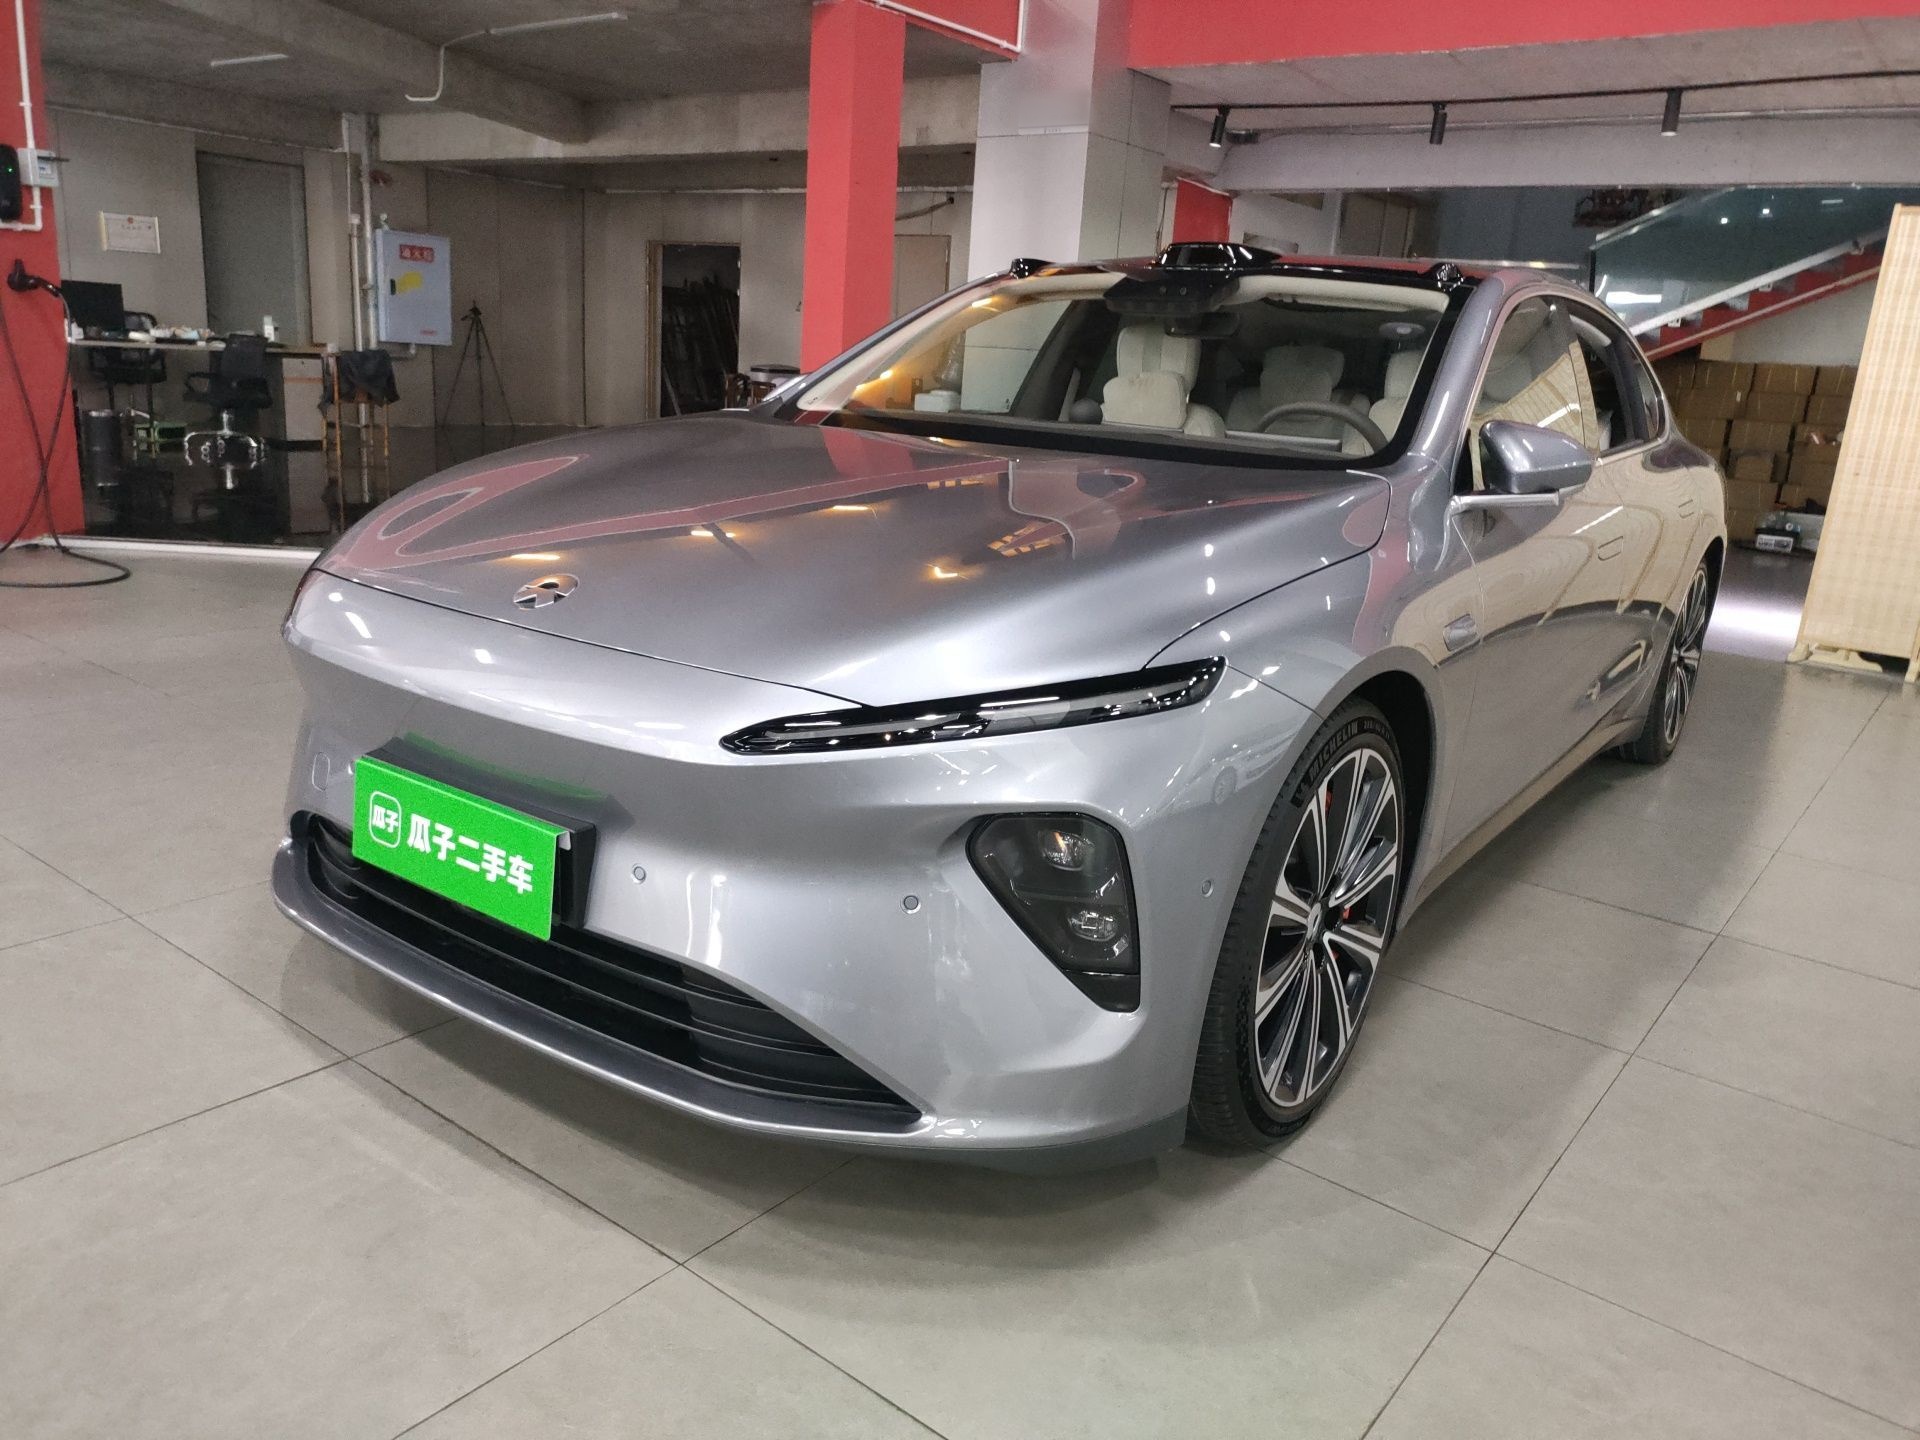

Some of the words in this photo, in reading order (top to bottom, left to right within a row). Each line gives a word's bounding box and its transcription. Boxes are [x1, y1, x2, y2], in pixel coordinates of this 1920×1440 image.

[1308, 719, 1358, 783] MICHELIN
[372, 804, 399, 833] 瓜子
[407, 813, 534, 895] 瓜子二手车
